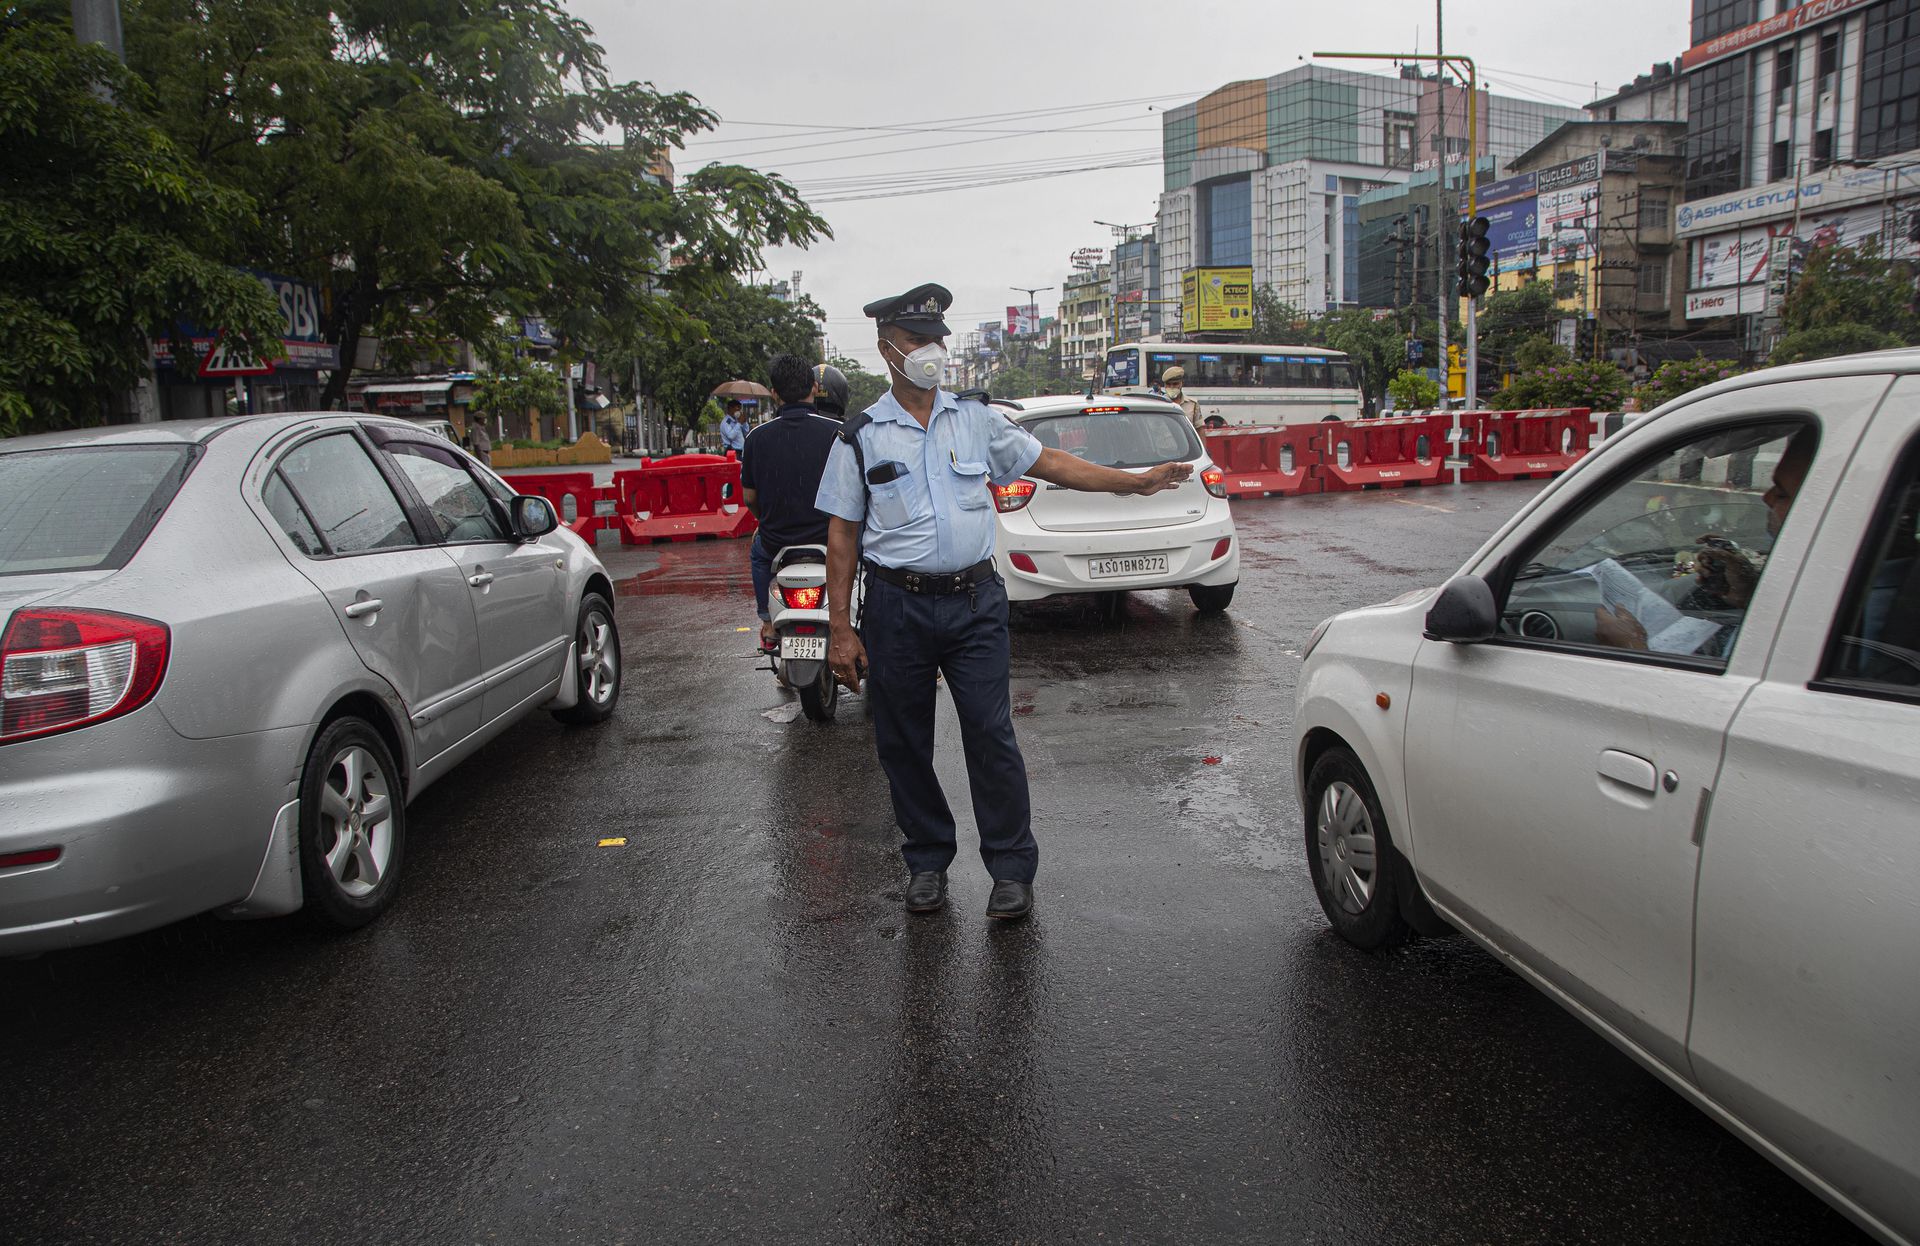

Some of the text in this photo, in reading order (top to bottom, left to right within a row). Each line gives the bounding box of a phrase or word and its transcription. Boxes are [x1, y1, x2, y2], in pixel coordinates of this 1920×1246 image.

[1540, 166, 1571, 185] NUCLEO
[1578, 159, 1597, 175] MED
[1694, 183, 1823, 220] ASHOK LEYLAND
[1224, 286, 1248, 294] XTECH
[280, 282, 319, 337] SBI
[1701, 297, 1725, 309] Hero
[1099, 557, 1165, 574] AS01BN8272
[793, 648, 817, 659] 5224
